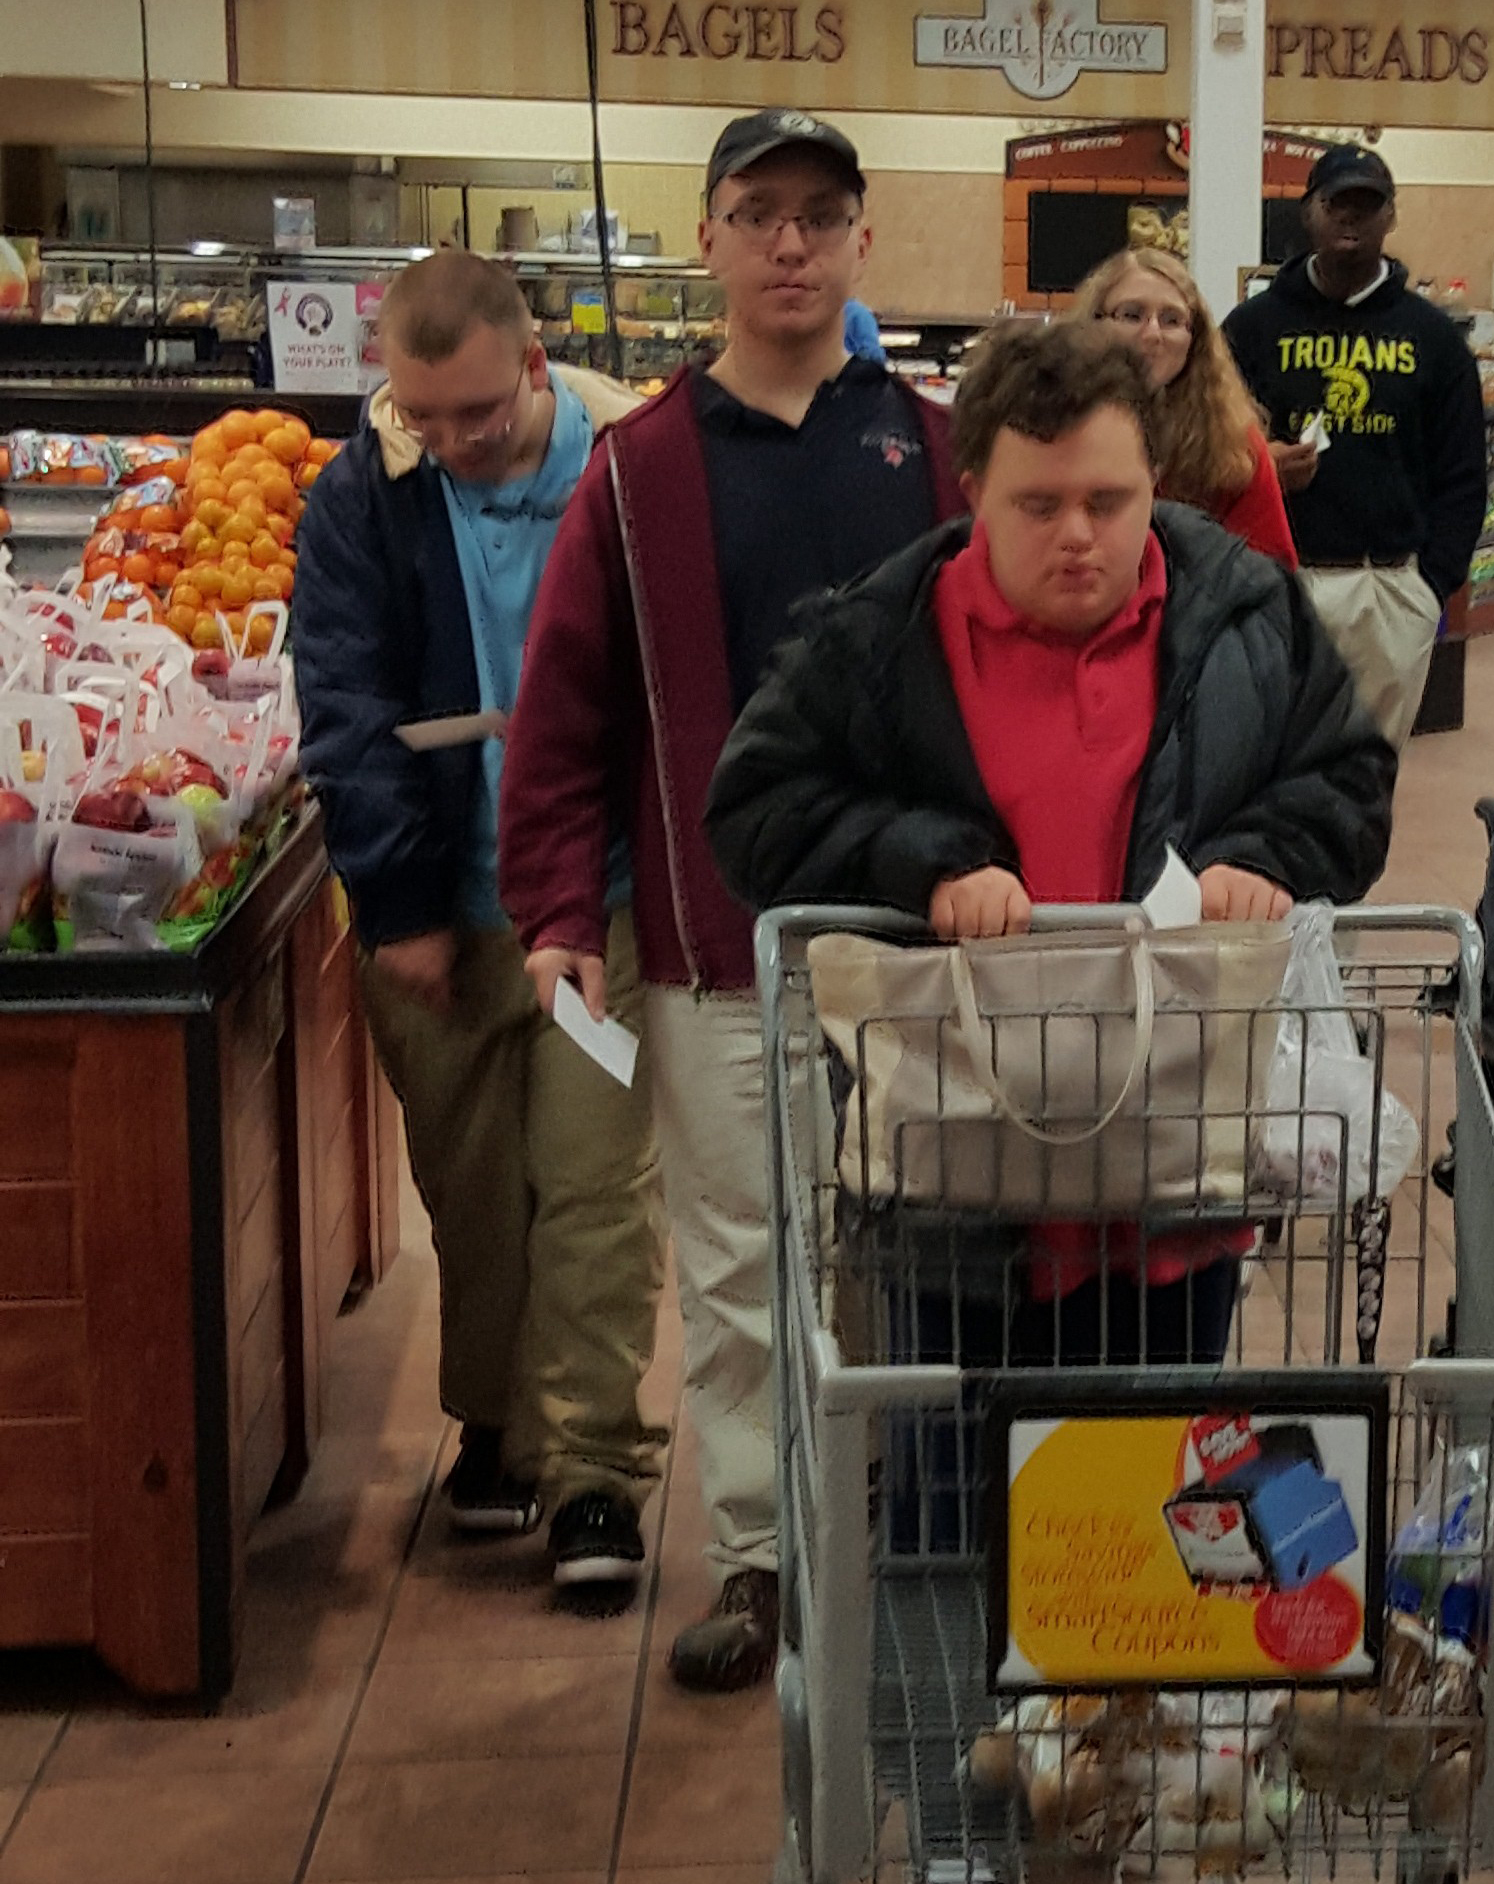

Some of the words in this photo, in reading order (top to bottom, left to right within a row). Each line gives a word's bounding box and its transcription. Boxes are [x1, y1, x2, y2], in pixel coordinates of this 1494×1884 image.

[610, 1, 845, 62] BAGELS
[943, 26, 1031, 54] BAGEL
[1267, 24, 1489, 83] PREADS
[1277, 334, 1416, 374] TROJANS
[1091, 1627, 1221, 1662] Coupons
